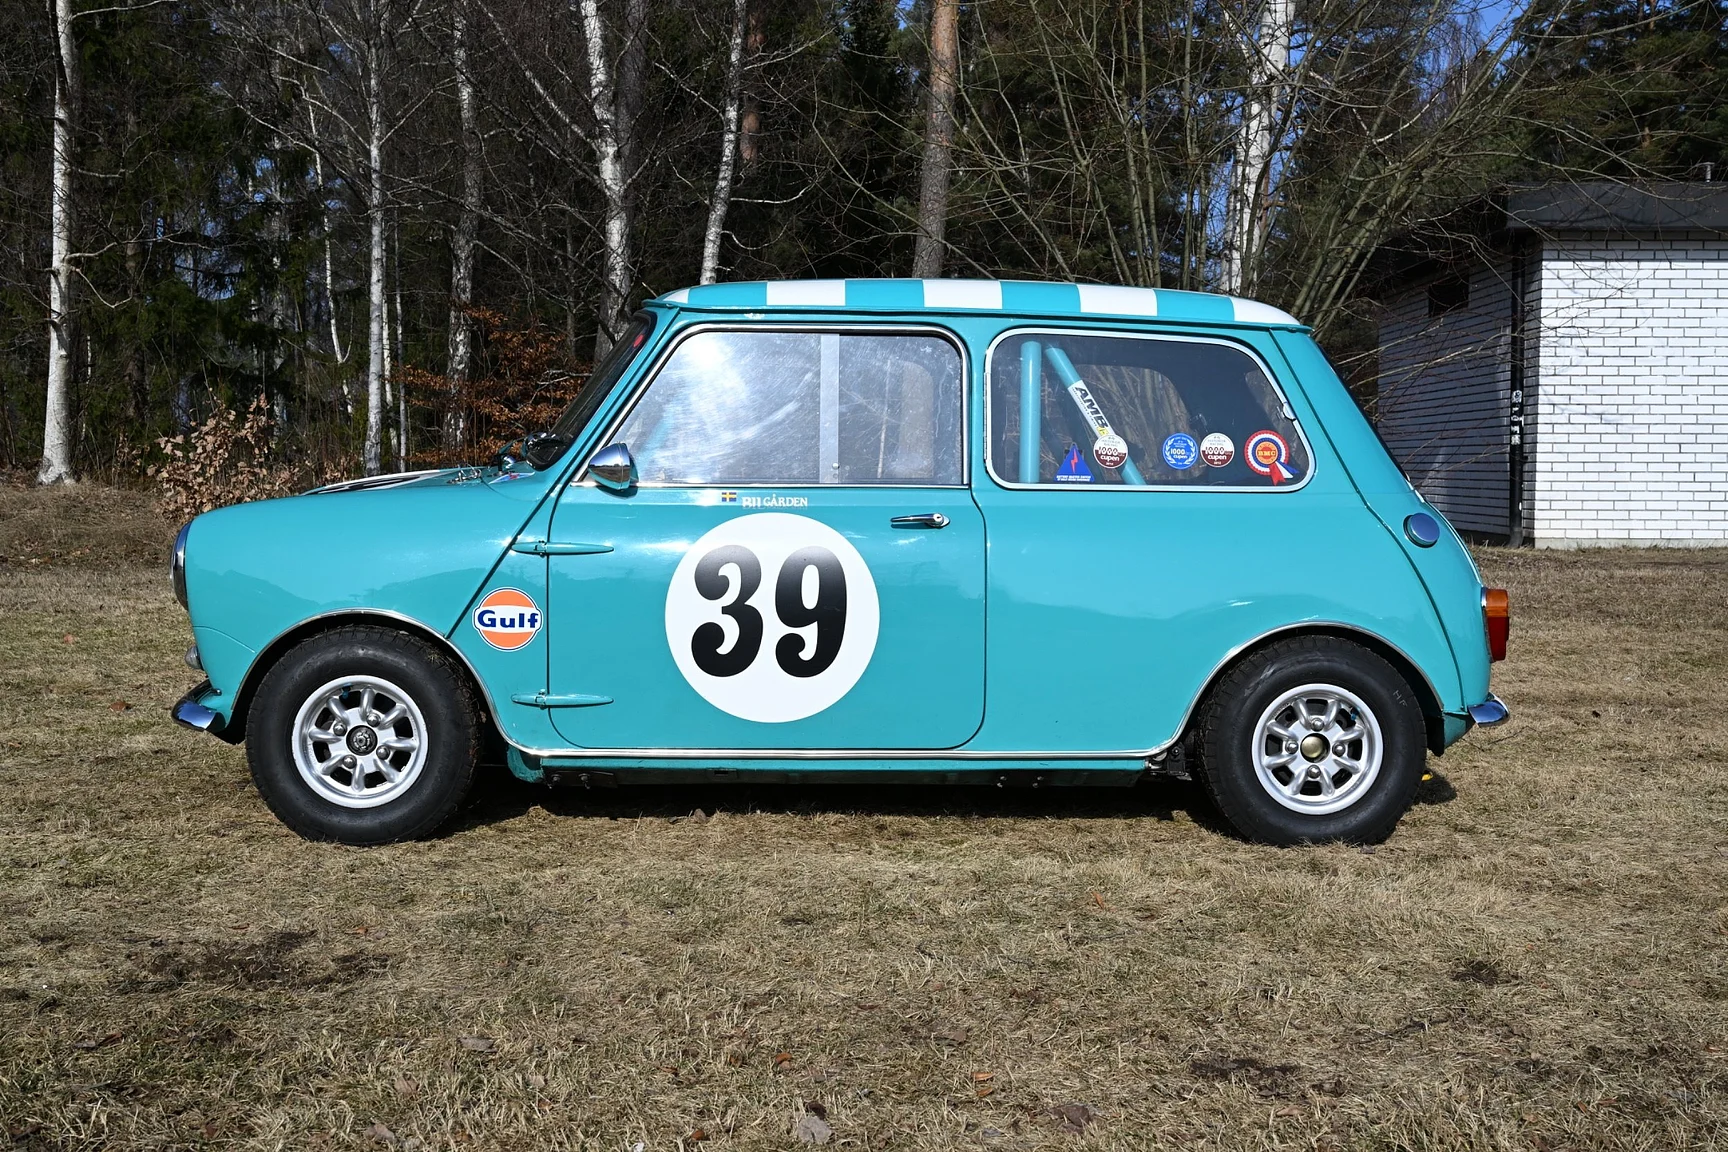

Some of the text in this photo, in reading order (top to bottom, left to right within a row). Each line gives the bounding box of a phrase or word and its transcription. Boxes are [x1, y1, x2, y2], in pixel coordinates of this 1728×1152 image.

[1098, 446, 1118, 457] 1000
[1205, 446, 1225, 455] 1000
[477, 609, 539, 628] Gulf
[691, 544, 847, 678] 39
